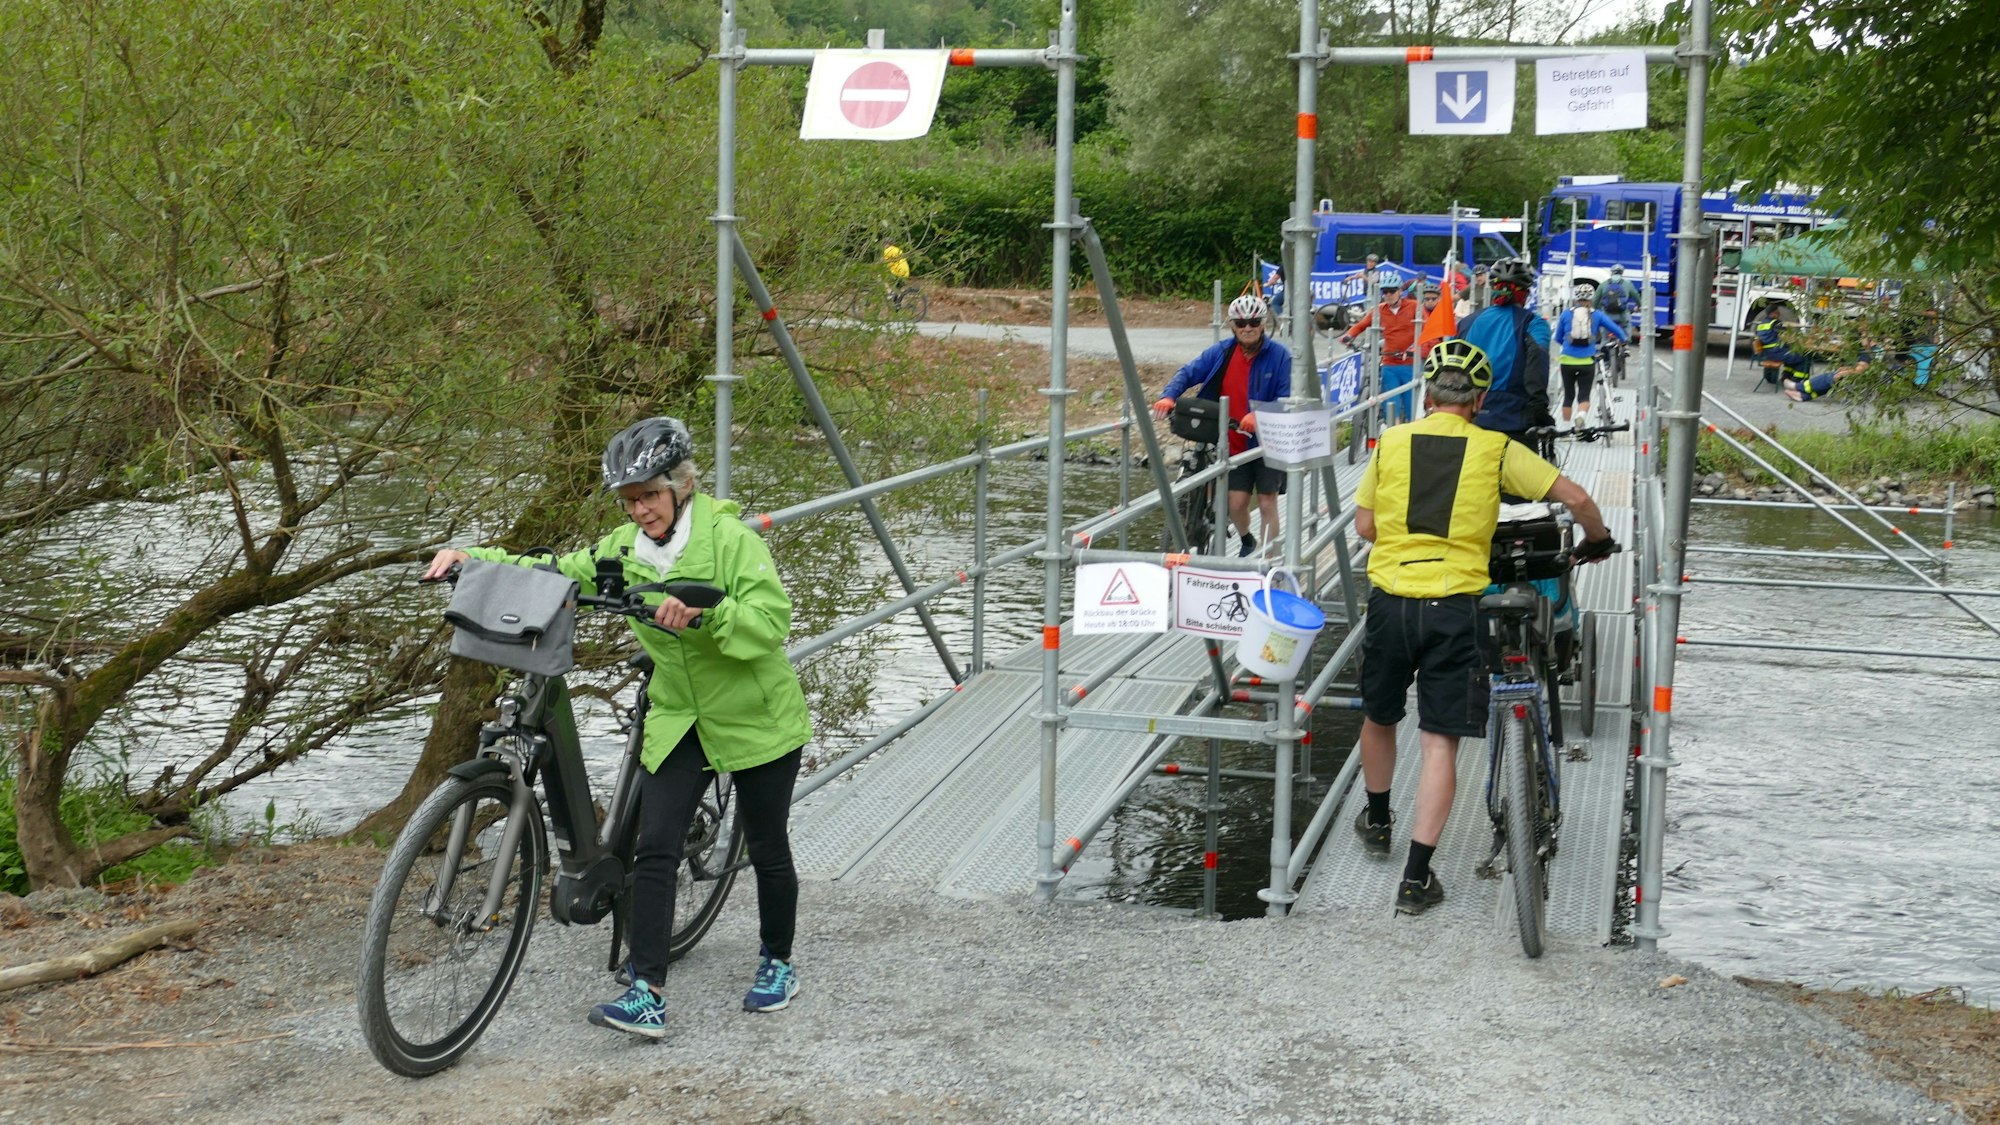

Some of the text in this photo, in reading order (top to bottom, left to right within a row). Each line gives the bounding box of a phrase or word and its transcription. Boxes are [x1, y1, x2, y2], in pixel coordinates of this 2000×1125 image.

[1552, 65, 1630, 82] Betreten auf
[1569, 85, 1613, 98] eigene
[1567, 99, 1615, 113] Gefahr!
[1732, 203, 1785, 214] Technisches
[1186, 577, 1230, 591] Fahrräder
[1084, 608, 1114, 617] Rückbau
[1130, 608, 1156, 616] Brücke
[1118, 620, 1139, 628] 18:00
[1185, 618, 1243, 632] Bitte schieben
